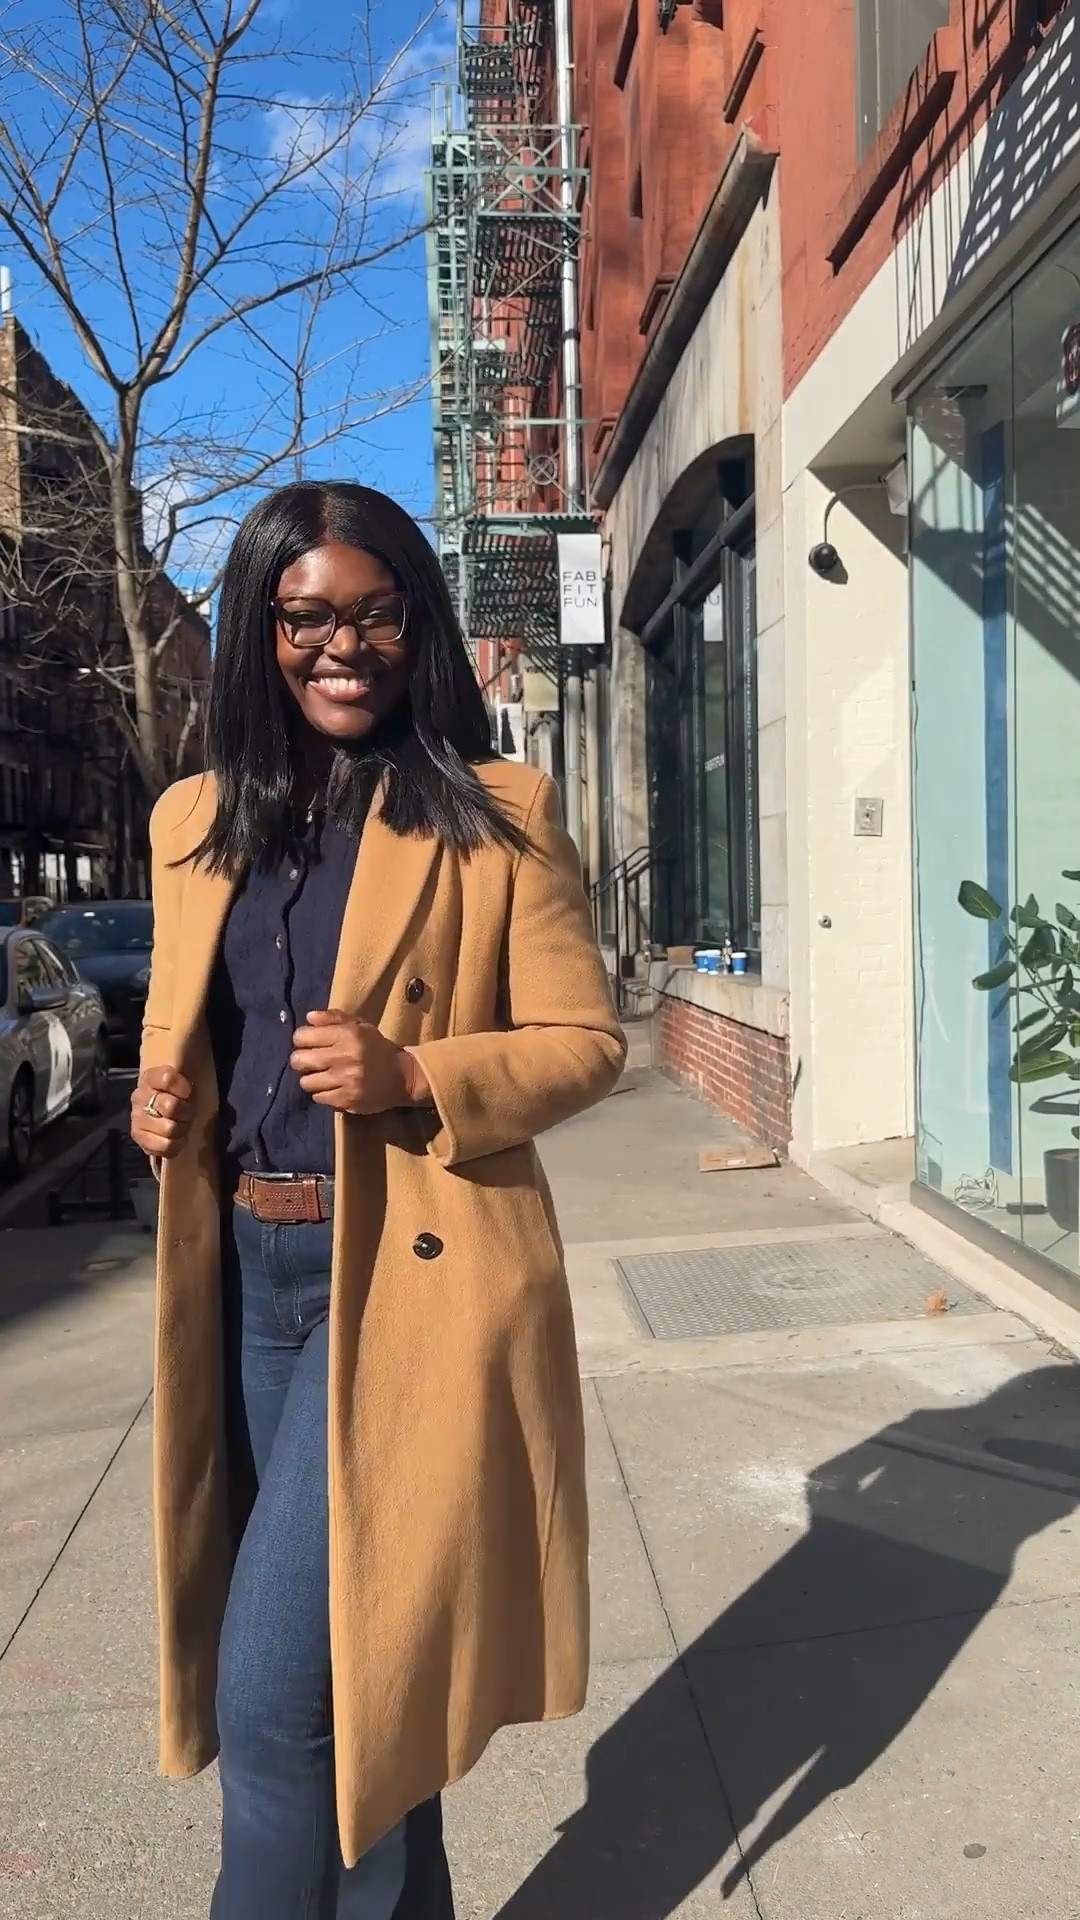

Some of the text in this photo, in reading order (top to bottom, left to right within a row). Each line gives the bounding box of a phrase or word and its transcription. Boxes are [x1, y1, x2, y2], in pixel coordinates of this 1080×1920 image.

[563, 571, 596, 582] FAB
[563, 584, 597, 595] FIT
[563, 597, 598, 608] FUN
